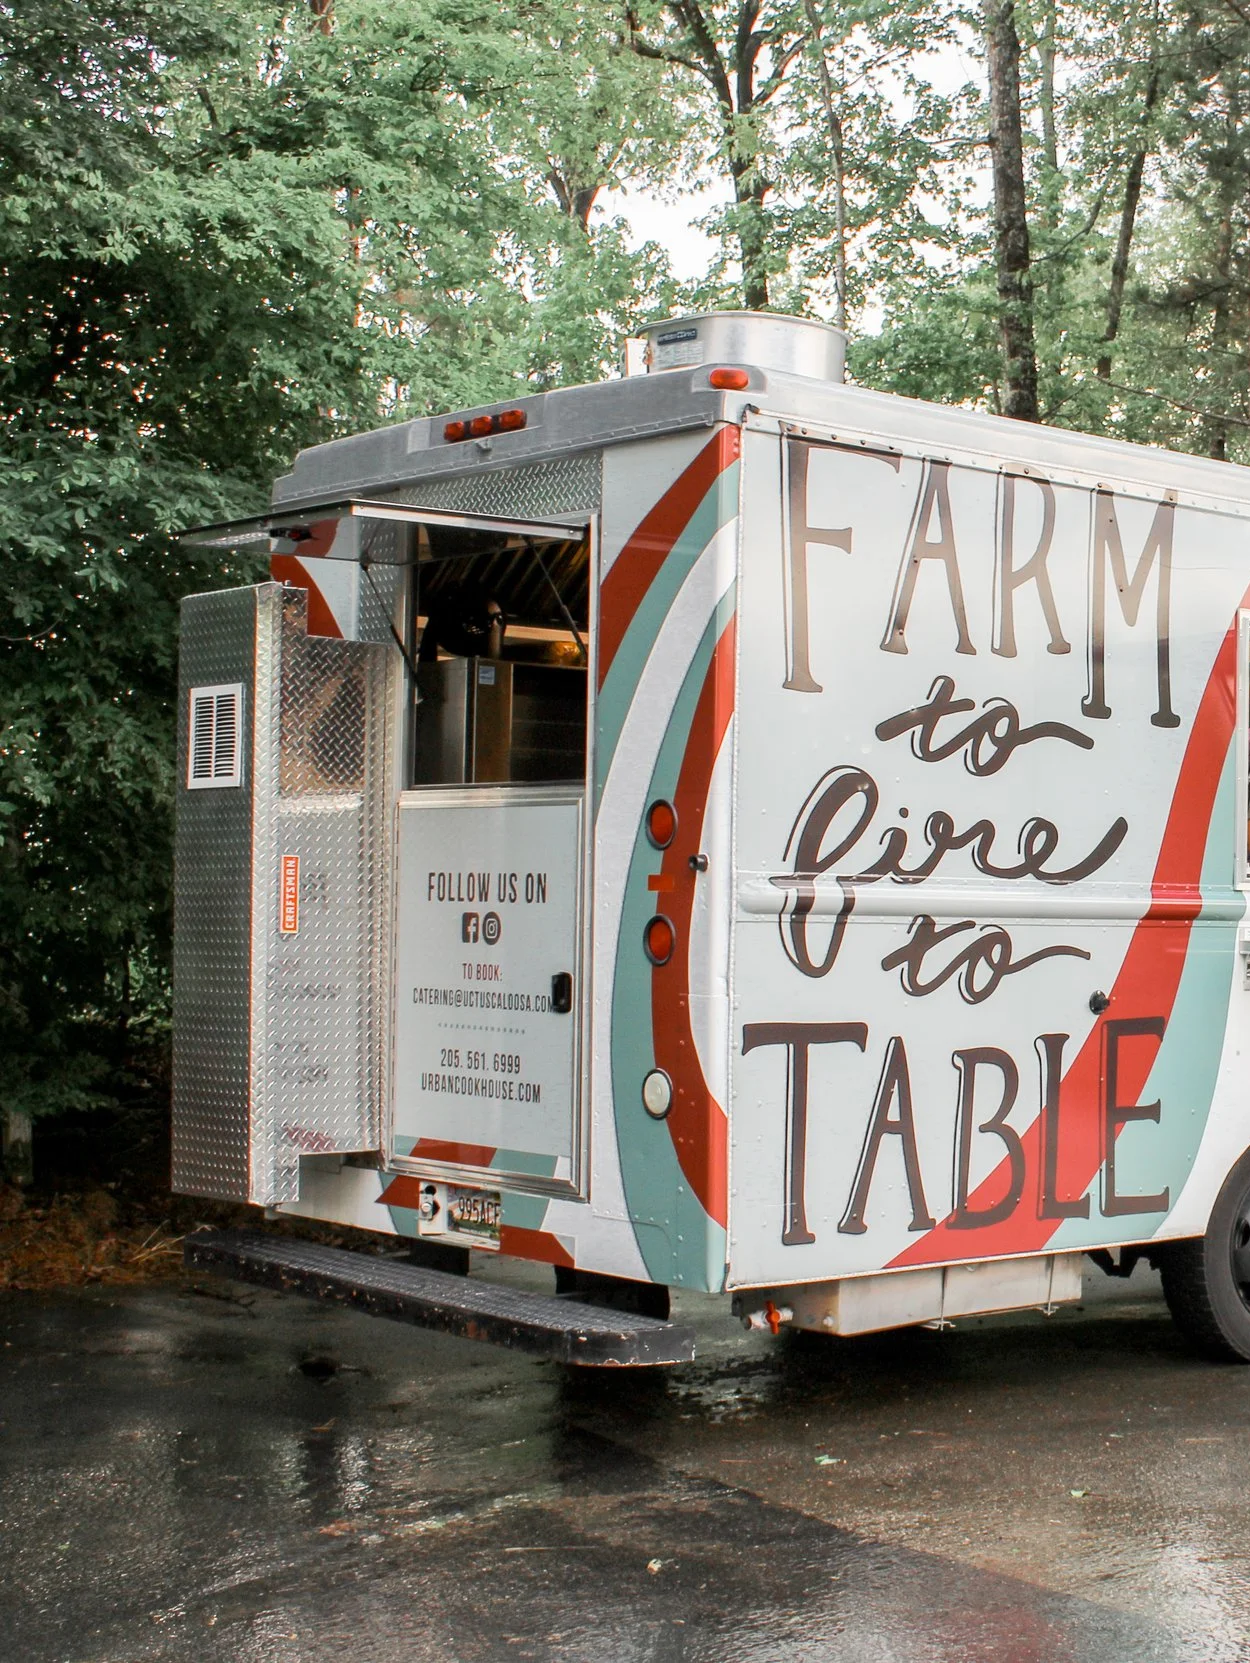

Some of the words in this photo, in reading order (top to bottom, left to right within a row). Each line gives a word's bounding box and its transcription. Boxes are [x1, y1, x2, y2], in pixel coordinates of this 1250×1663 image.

[779, 421, 1181, 728] FARM
[875, 675, 1095, 777] to
[285, 859, 296, 929] CRAFTSMAN
[427, 872, 491, 902] FOLLOW
[497, 872, 518, 903] US
[525, 872, 547, 904] ON
[768, 764, 1129, 978] fire
[462, 963, 473, 981] TO
[476, 964, 503, 982] BOOK:
[881, 913, 1091, 1004] to
[421, 1072, 541, 1104] URBANCOOKHOUSE.COM
[440, 1048, 463, 1068] 205.
[467, 1050, 489, 1072] 561.
[493, 1054, 521, 1075] 6999
[742, 1015, 1170, 1246] TABLE
